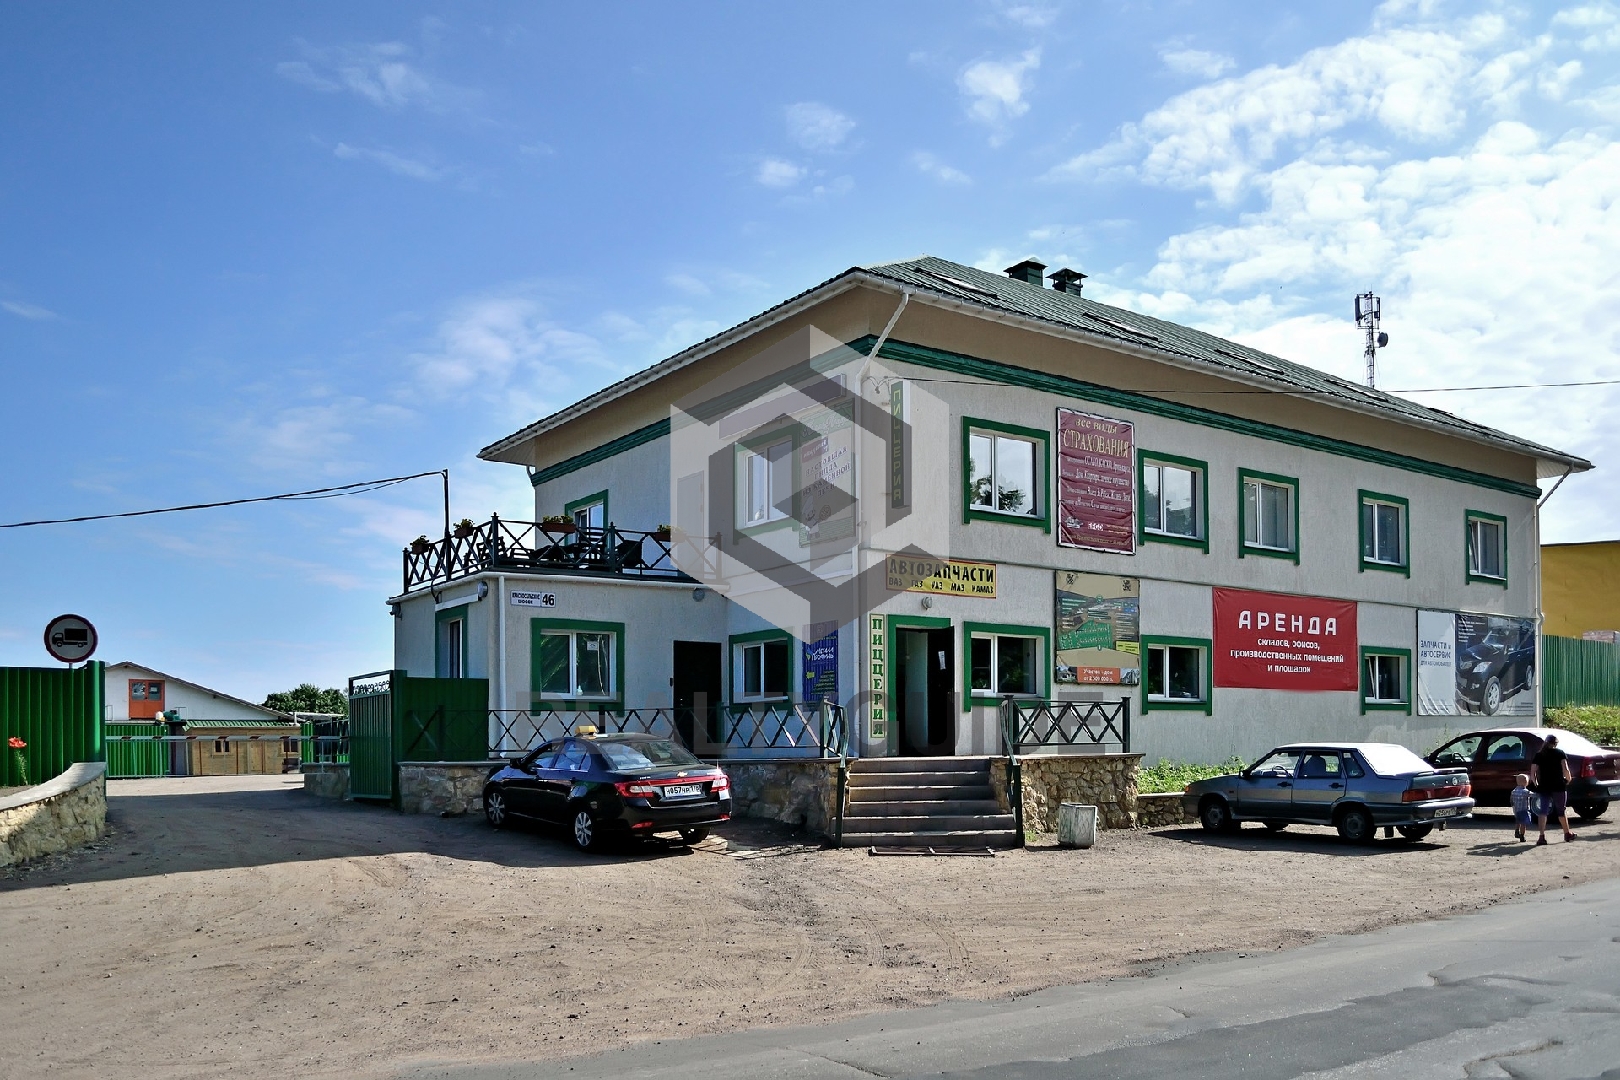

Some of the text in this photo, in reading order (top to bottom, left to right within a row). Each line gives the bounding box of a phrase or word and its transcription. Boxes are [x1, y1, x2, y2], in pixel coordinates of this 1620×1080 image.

[892, 388, 902, 501] ПИЦЦЕРИЯ
[1063, 428, 1129, 458] СТРАХОВАНИЯ
[889, 559, 994, 583] АВТОЗАПЧАСТИ
[889, 577, 994, 594] ВАЗ ГАЗ УАЗ МАЗ КАМАЗ
[542, 593, 555, 606] 46
[1238, 610, 1337, 636] АРЕНДА
[1257, 638, 1320, 650] складов, офисов,
[1420, 640, 1447, 650] ЗАПЧАСТИ
[1230, 649, 1344, 663] производственных помещений
[1420, 650, 1451, 659] АВТОСЕРВИС
[872, 618, 884, 735] ПИЦЦЕРИЯ
